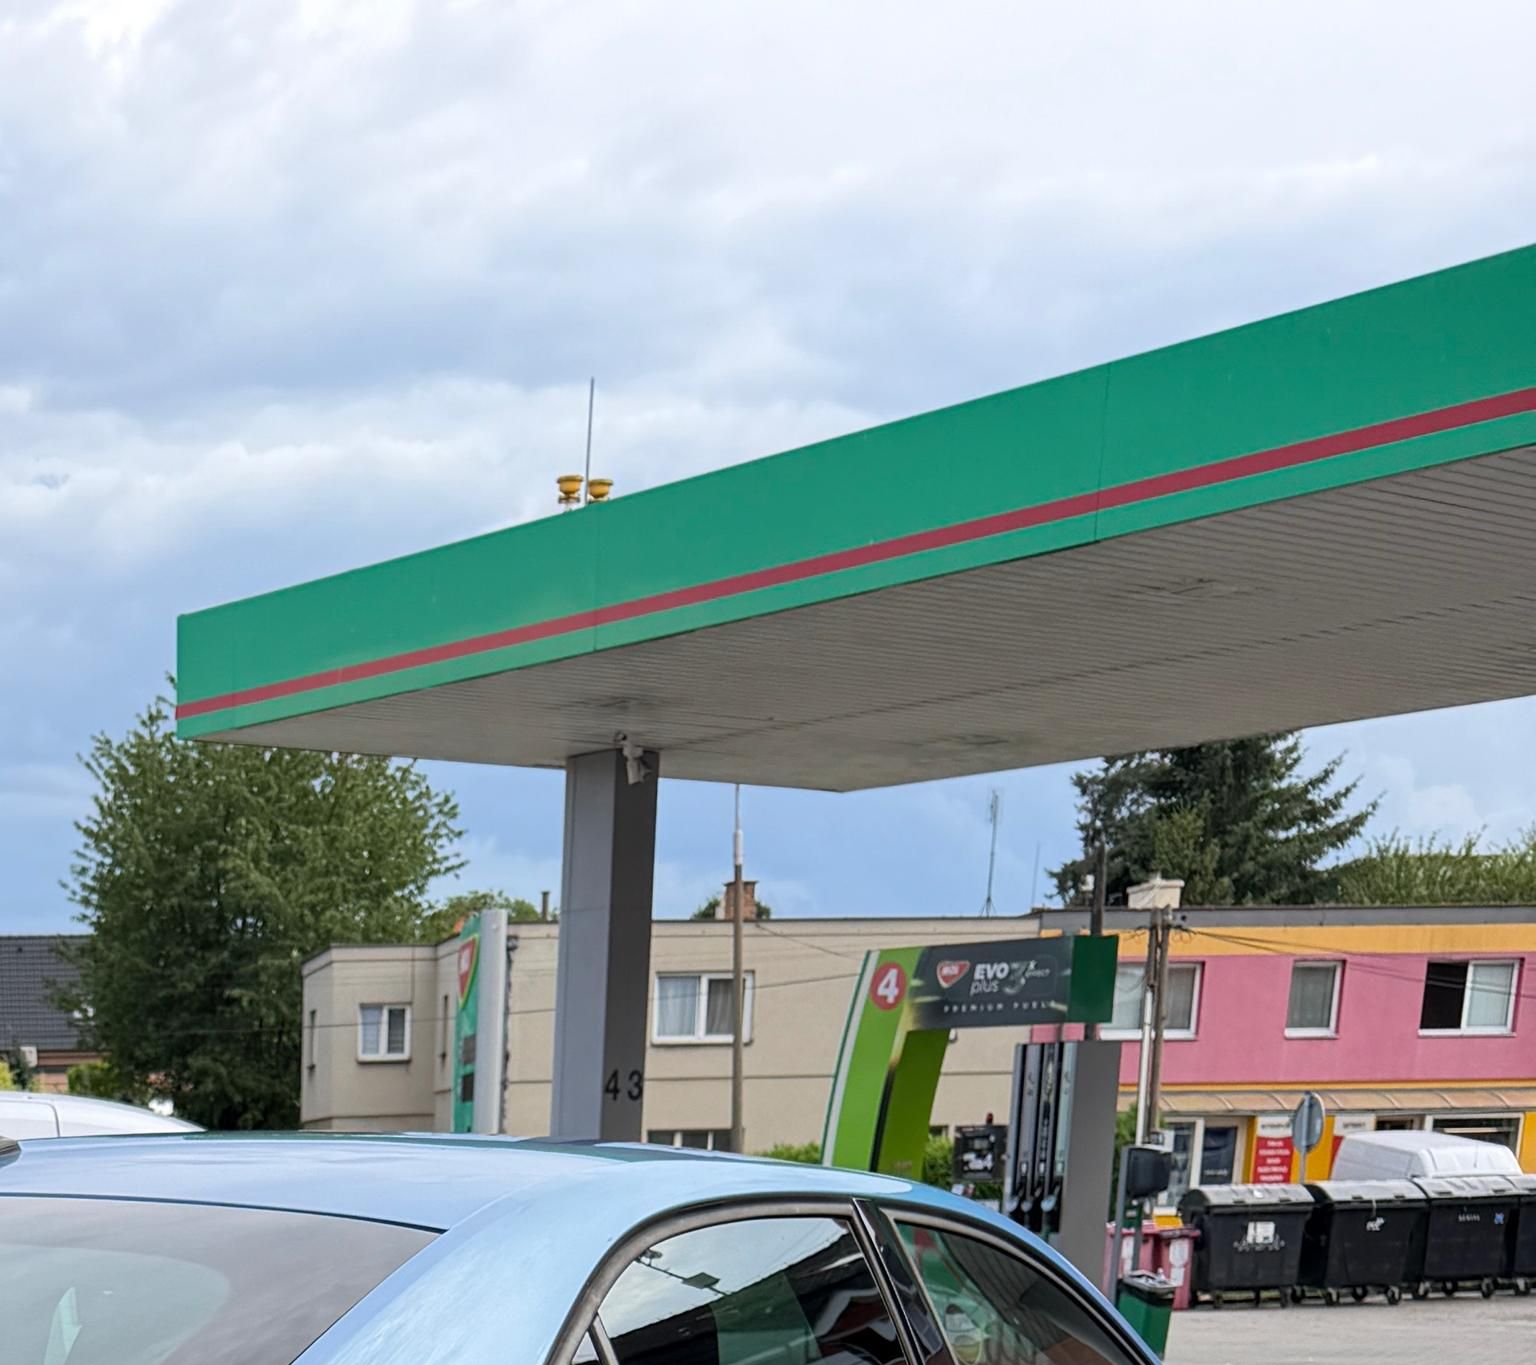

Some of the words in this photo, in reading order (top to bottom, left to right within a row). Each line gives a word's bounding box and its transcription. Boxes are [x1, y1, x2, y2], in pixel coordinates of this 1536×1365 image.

[973, 962, 1009, 980] EVO
[877, 967, 899, 1003] 4
[969, 979, 999, 997] plus
